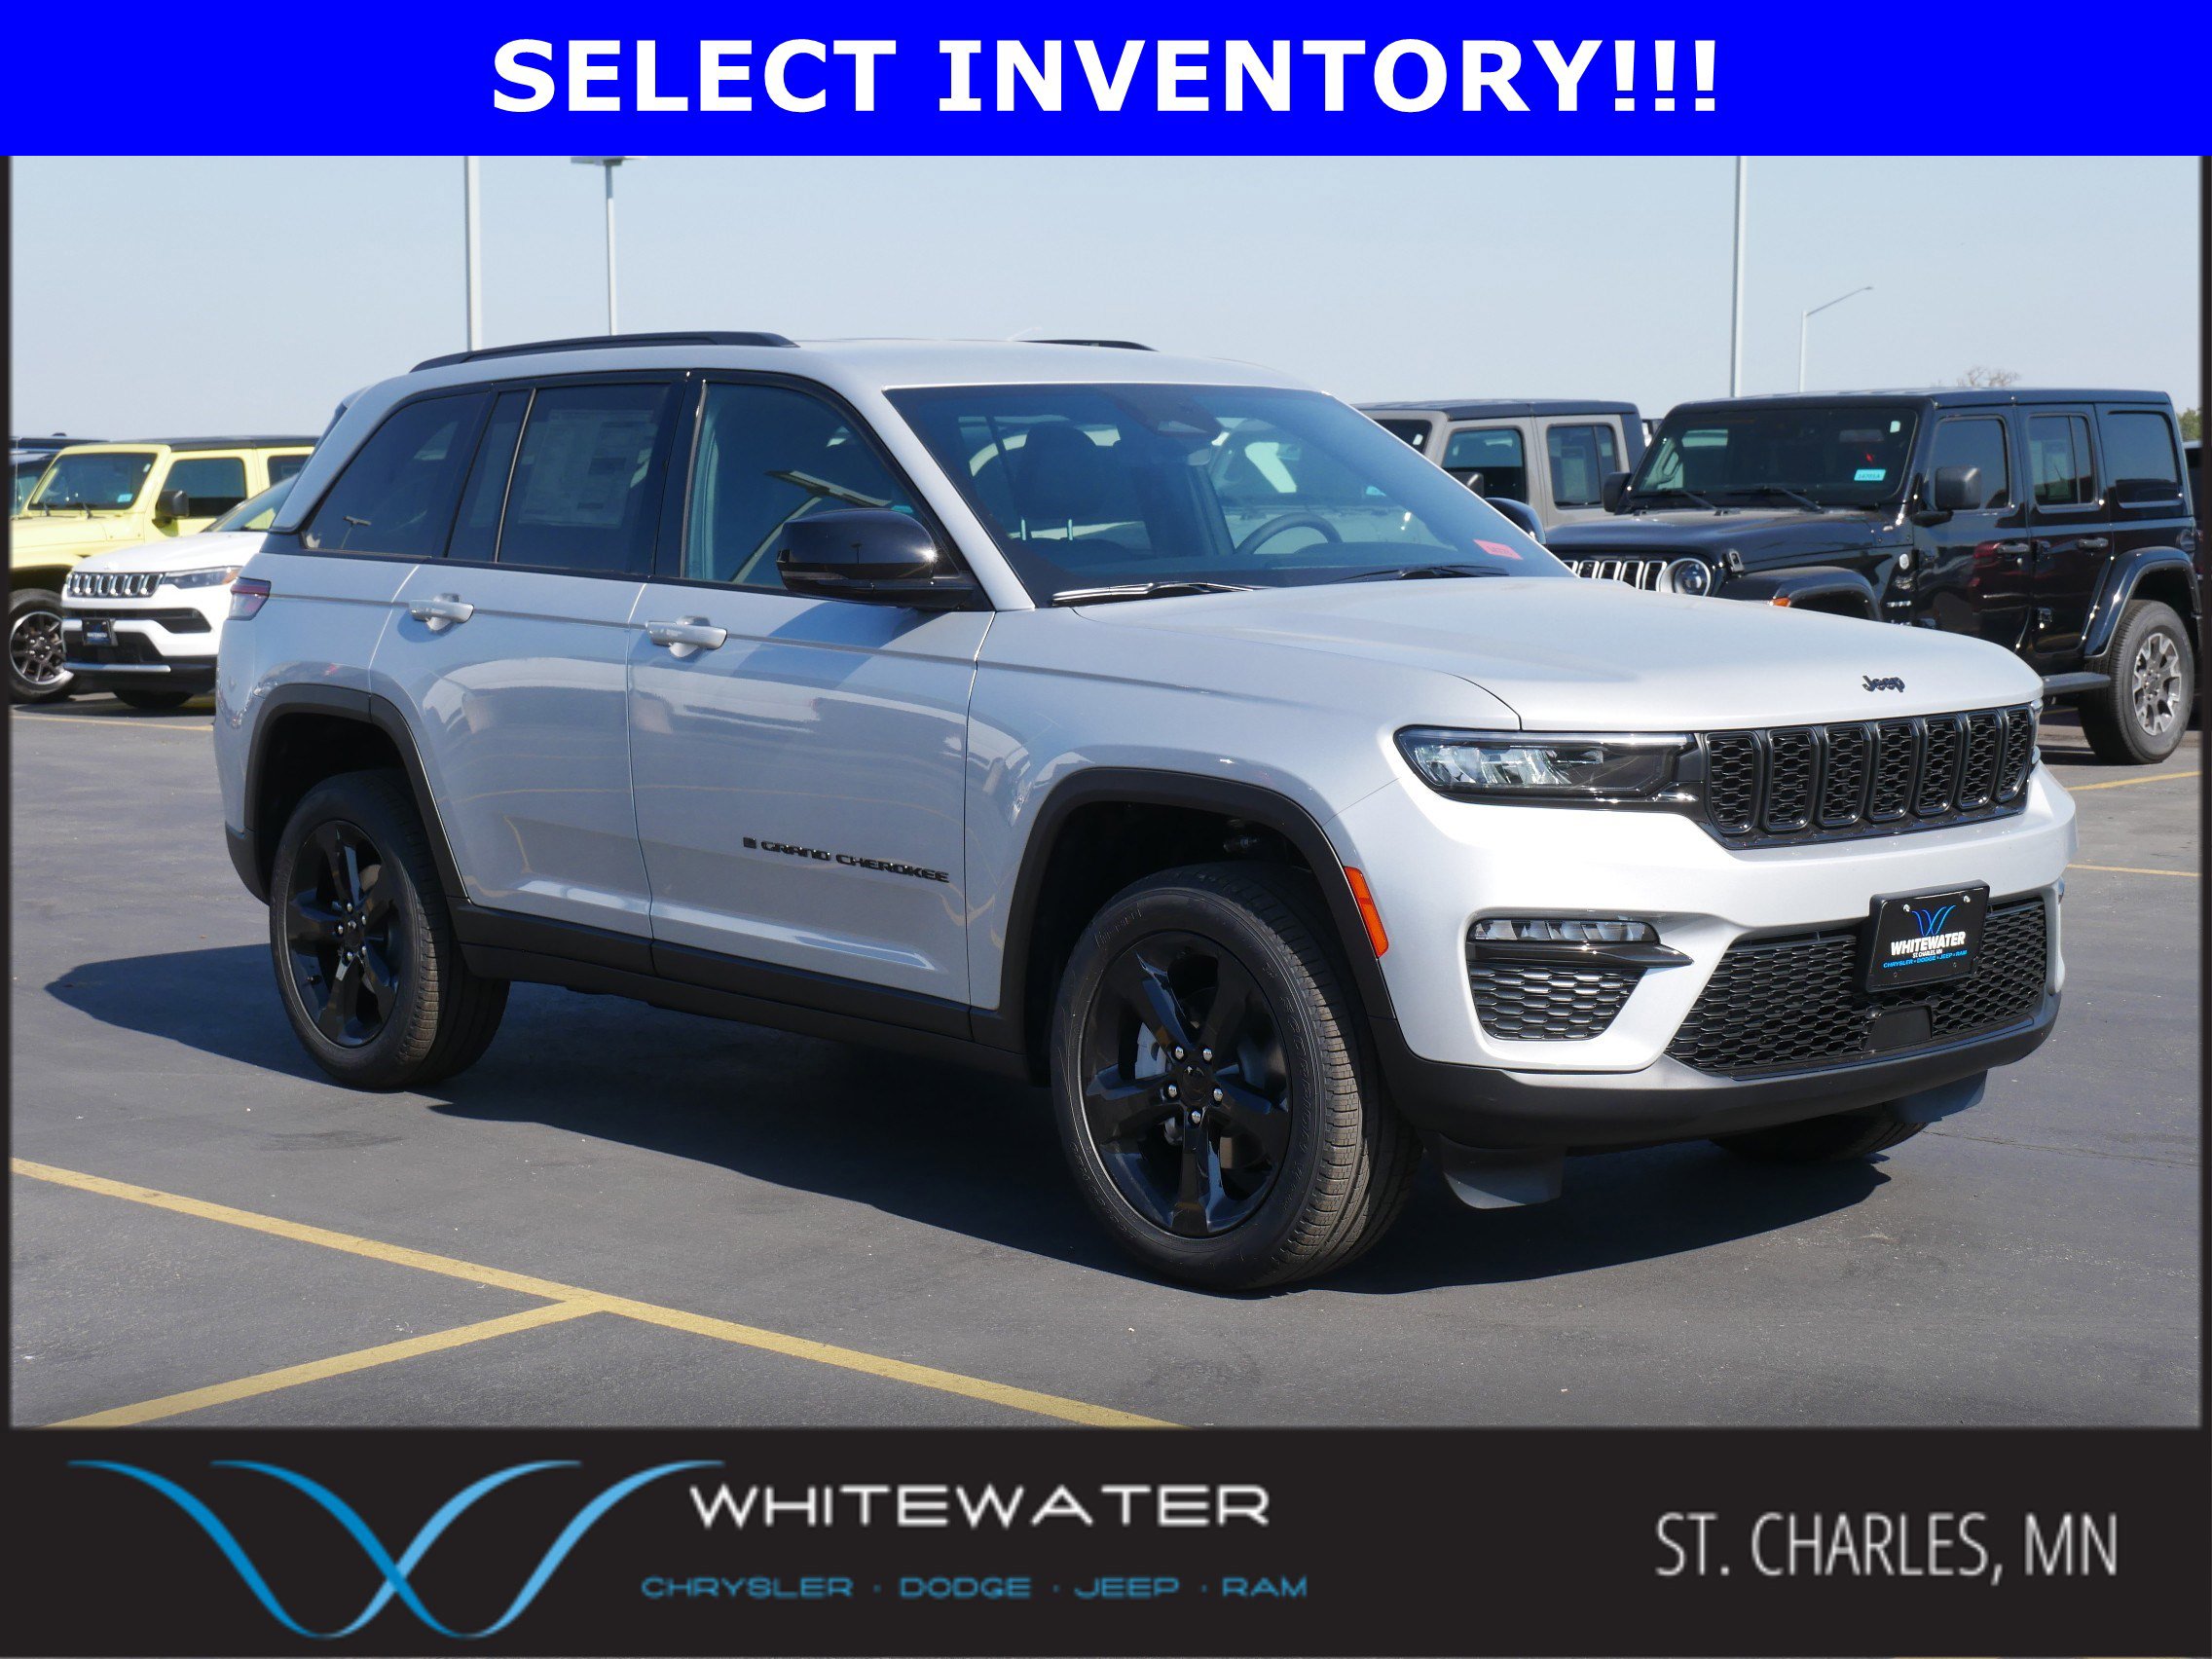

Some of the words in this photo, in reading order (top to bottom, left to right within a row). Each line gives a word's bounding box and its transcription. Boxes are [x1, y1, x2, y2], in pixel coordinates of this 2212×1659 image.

[1862, 675, 1905, 693] Jeep
[760, 840, 831, 862] GRAND
[835, 854, 950, 883] CHEROKEE
[1891, 932, 1966, 955] WHITEWATER
